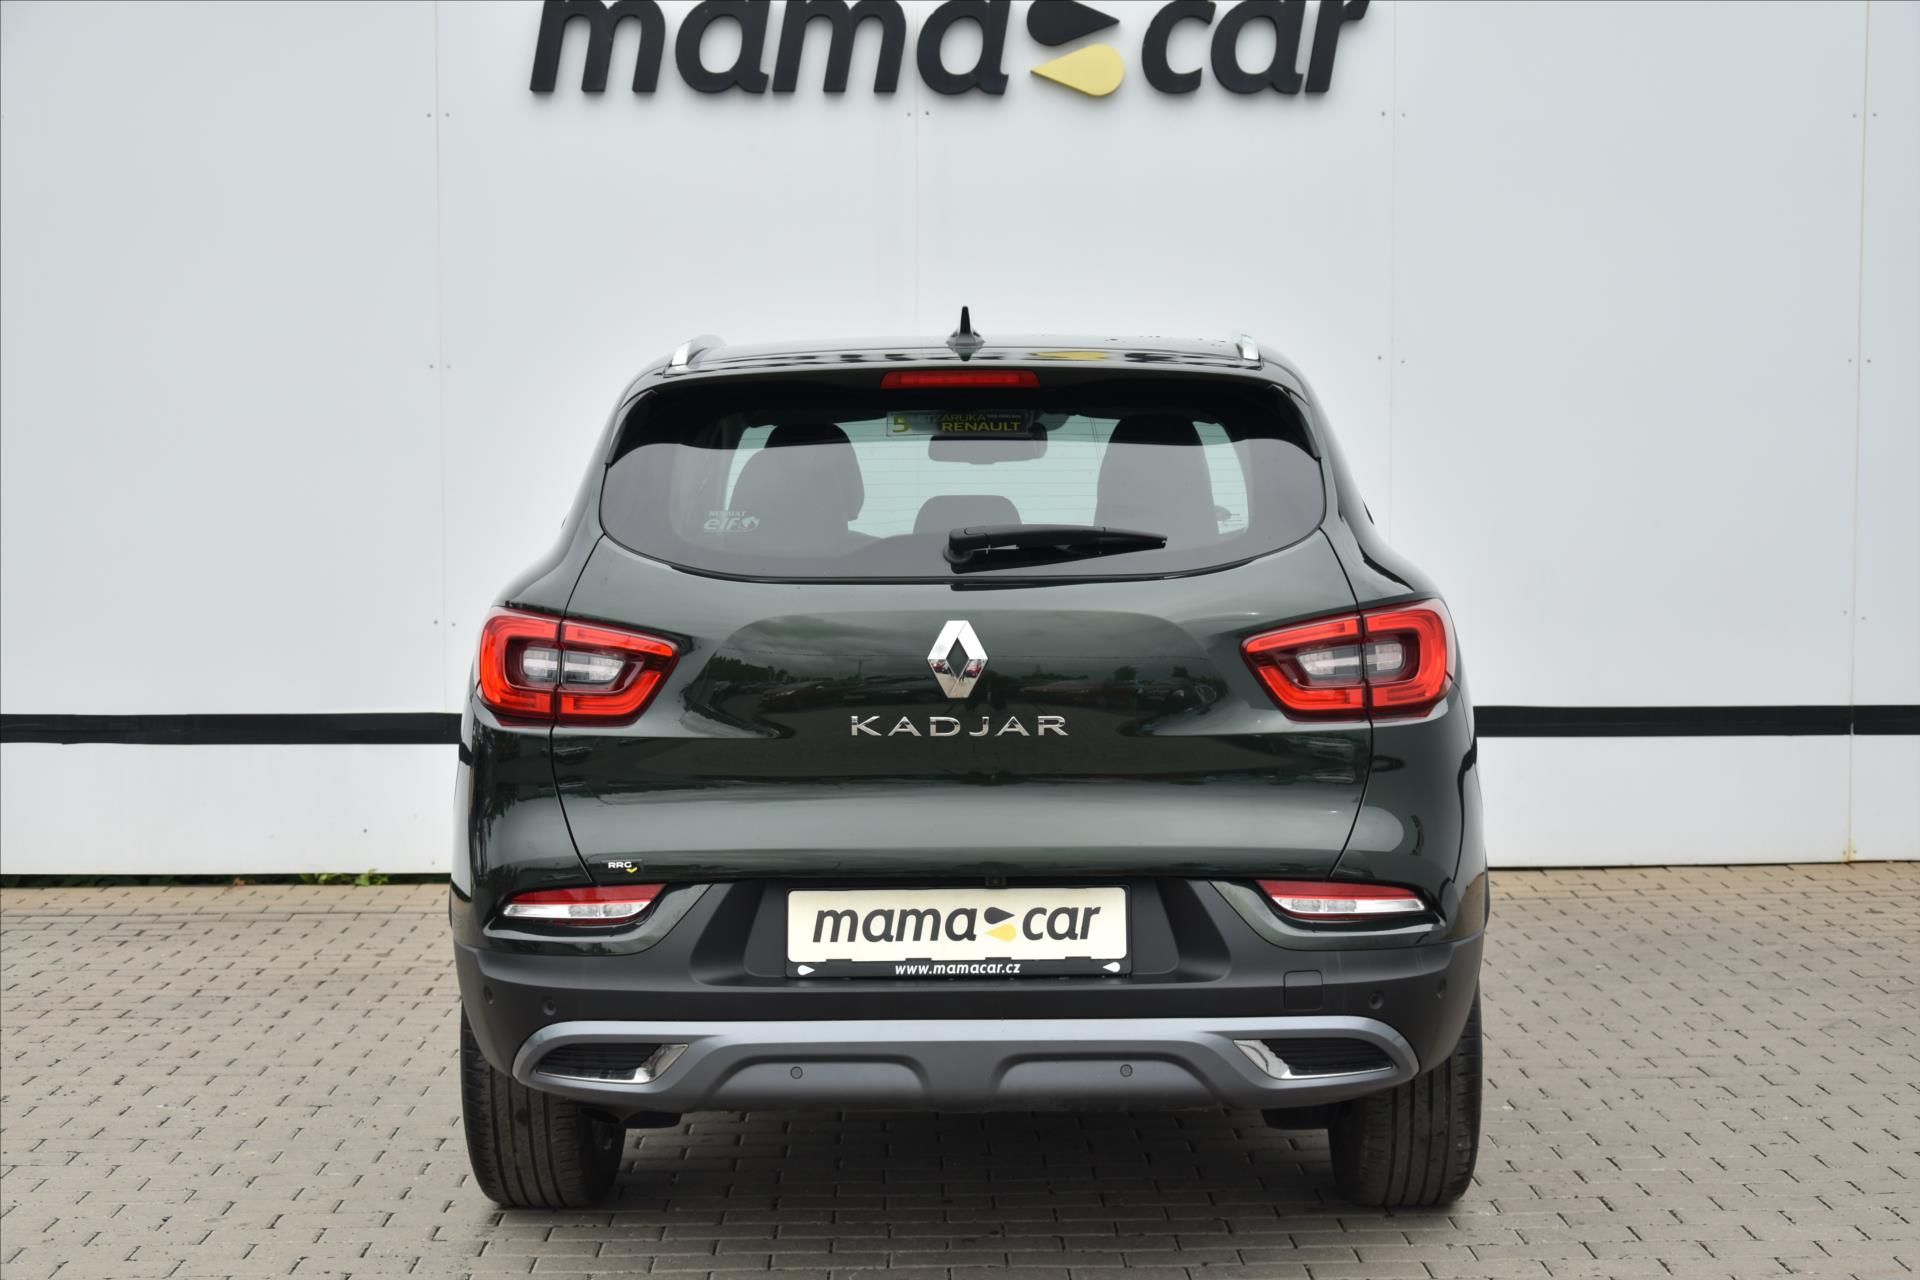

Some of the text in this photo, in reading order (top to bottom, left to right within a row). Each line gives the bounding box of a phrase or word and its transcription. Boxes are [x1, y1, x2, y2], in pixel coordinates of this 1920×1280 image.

[892, 416, 910, 432] 5
[942, 421, 1021, 432] RENAULT
[850, 715, 1069, 737] KADJAR
[812, 905, 1101, 943] mama car
[894, 961, 1021, 975] www.mamacar.cz
